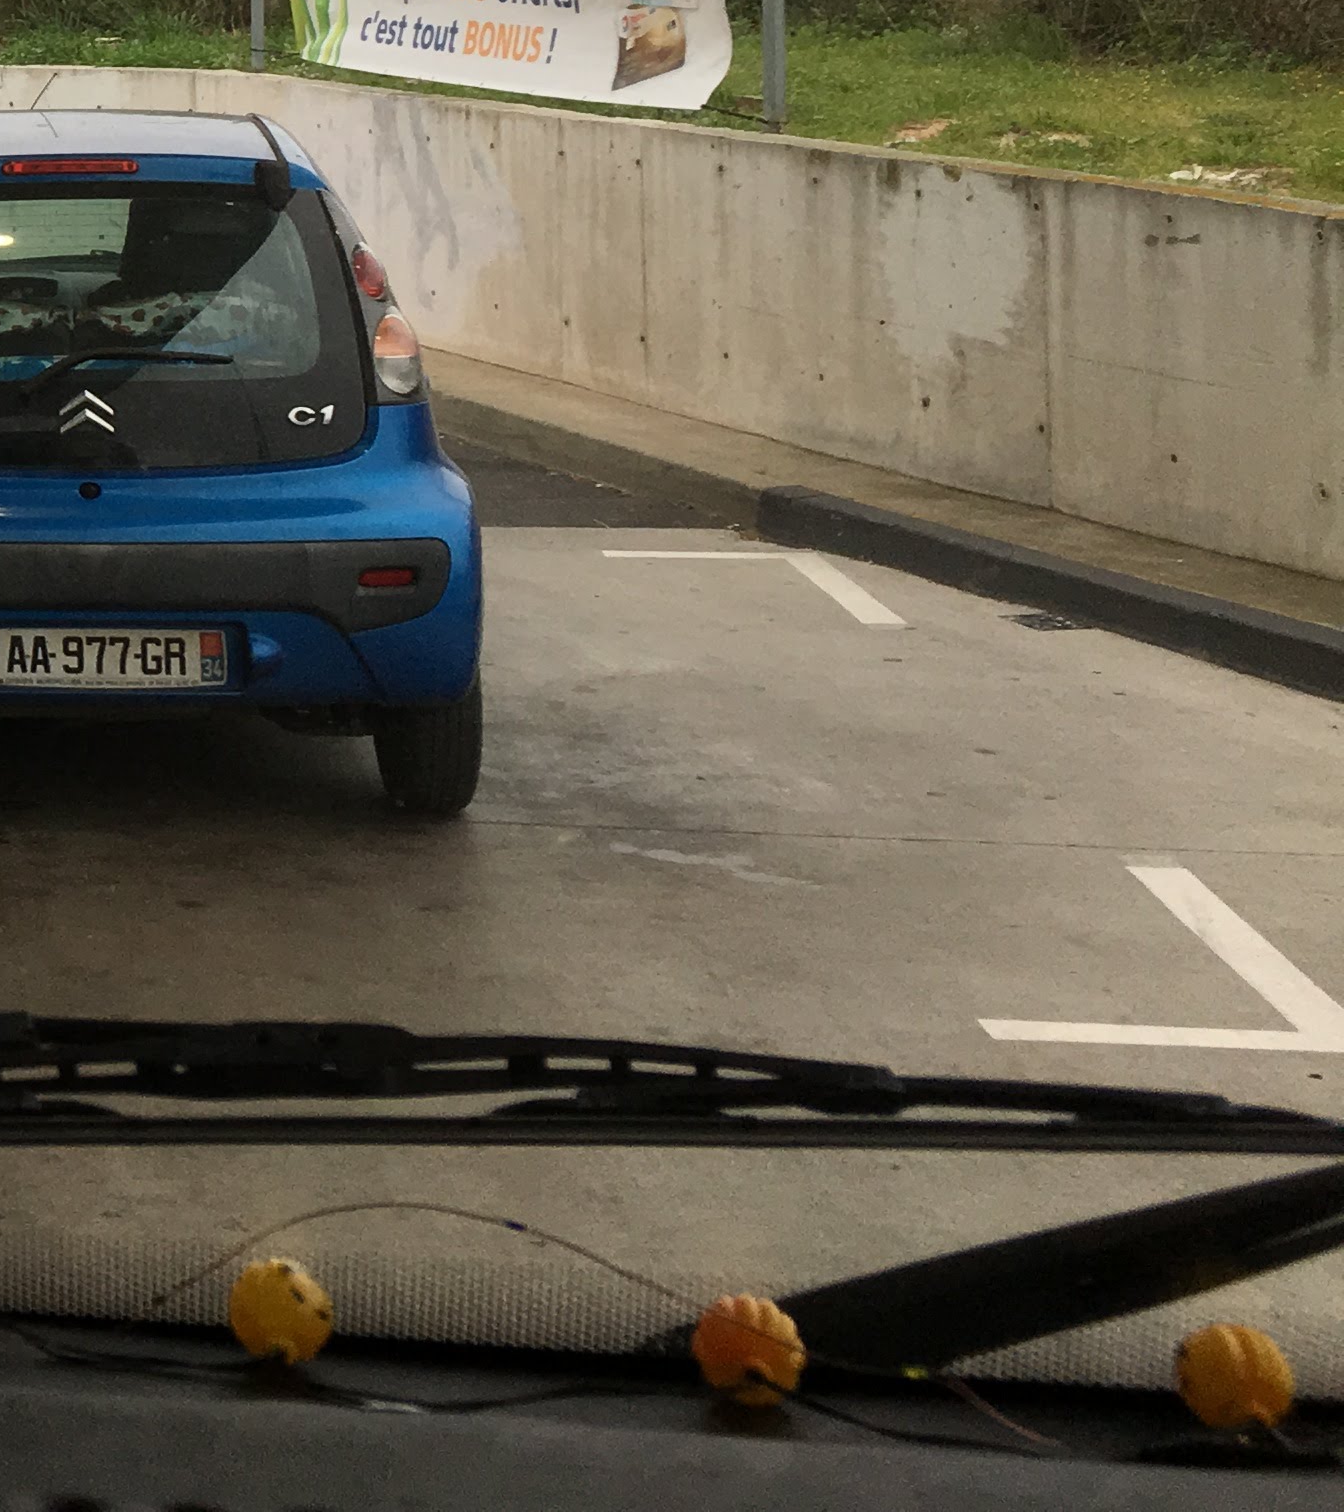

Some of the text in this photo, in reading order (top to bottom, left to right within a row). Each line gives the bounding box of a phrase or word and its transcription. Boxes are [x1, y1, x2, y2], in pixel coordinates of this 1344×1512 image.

[360, 10, 558, 64] c'est tout BONUS !
[288, 404, 334, 425] C1
[7, 635, 187, 676] AA-977-GR
[200, 657, 223, 678] 34
